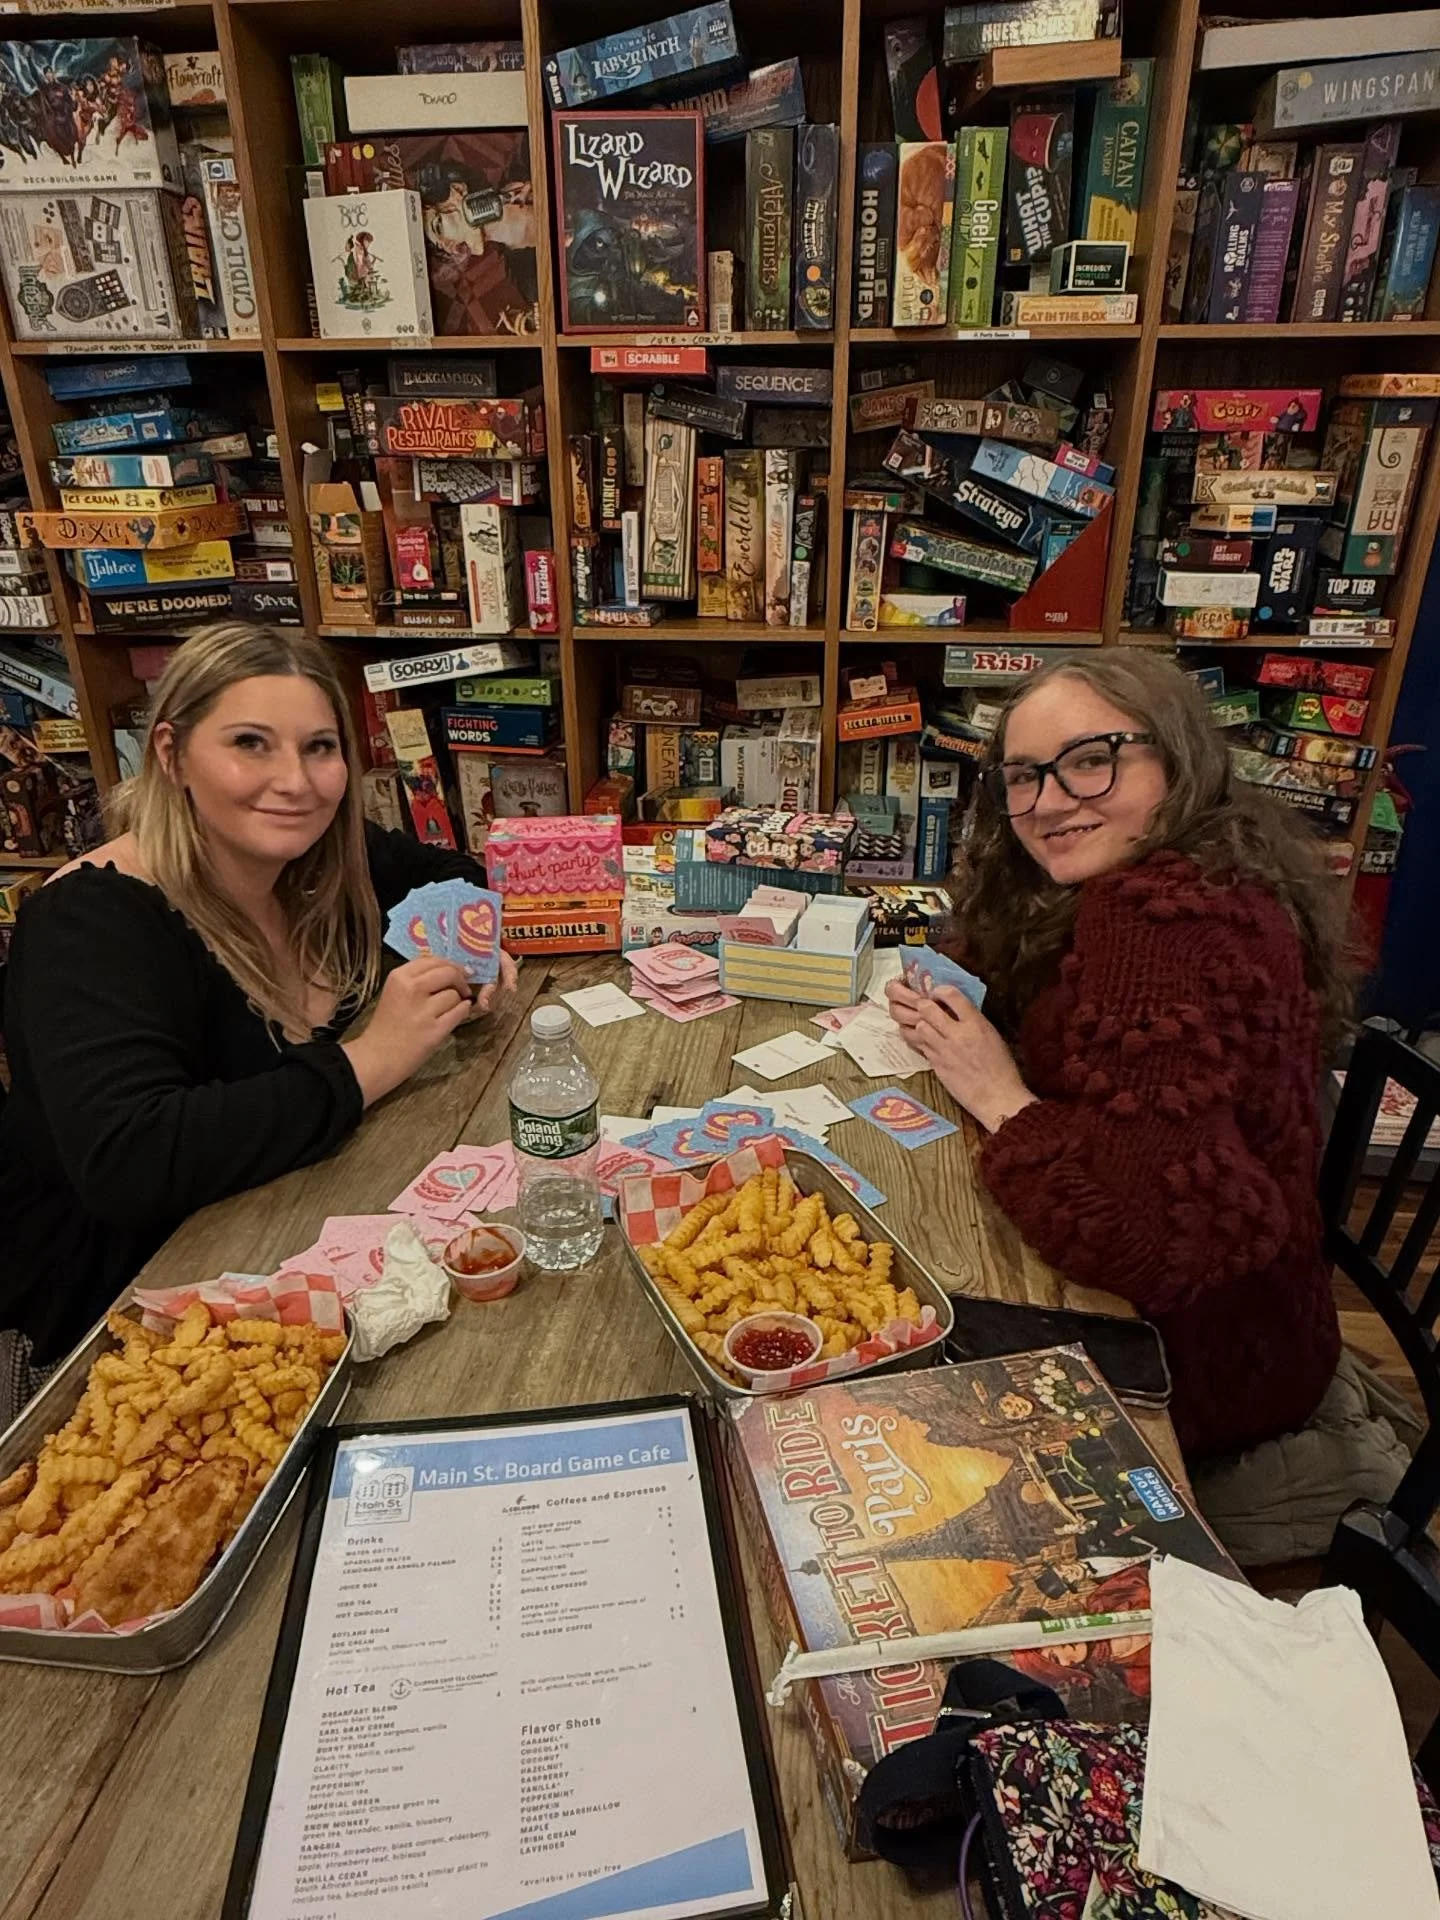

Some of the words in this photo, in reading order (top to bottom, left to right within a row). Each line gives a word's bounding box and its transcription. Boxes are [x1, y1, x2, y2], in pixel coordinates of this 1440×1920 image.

[435, 54, 464, 73] Moon
[591, 35, 682, 80] LABYRINTH
[1324, 71, 1435, 105] WINGSPAN
[1101, 136, 1113, 176] JUNIOR
[1117, 121, 1139, 189] CATAN
[93, 174, 118, 183] GAME
[758, 160, 784, 286] Alchemists
[969, 199, 998, 248] Geek
[1016, 192, 1042, 254] WHAT
[1320, 199, 1344, 230] My
[1041, 225, 1053, 248] THE
[182, 196, 217, 305] TRAINS
[858, 188, 879, 322] HORRIFIED
[1223, 224, 1240, 273] ROLLING
[1235, 229, 1249, 267] REALMS
[1020, 311, 1047, 323] CAT
[1048, 311, 1060, 322] IN
[1060, 311, 1082, 322] THE
[1083, 310, 1108, 322] BOX
[692, 335, 720, 345] COZY
[624, 351, 680, 366] SCRABBLE
[403, 371, 484, 387] BACKGAMMON
[735, 374, 814, 393] SEQUENCE
[399, 401, 460, 431] RIVAL
[667, 400, 724, 419] MASTERMIND
[386, 426, 477, 452] RESTAURANTS
[64, 495, 83, 504] ICE
[85, 494, 121, 505] CREAM
[602, 477, 616, 518] DISTRICT
[953, 479, 1024, 530] Stratego
[727, 494, 758, 580] Everdell
[1213, 545, 1228, 553] ART
[89, 556, 137, 582] Yahtzee
[1269, 549, 1284, 589] STAR
[1274, 548, 1296, 593] WARS
[414, 592, 429, 600] Mind
[1327, 578, 1349, 595] TOP
[1350, 579, 1376, 595] TIER
[106, 598, 160, 616] WE'RE
[161, 593, 233, 611] DOOMED!
[1193, 608, 1231, 624] VEGAS
[393, 657, 450, 680] SORRY!
[973, 653, 1042, 673] Risk
[447, 717, 499, 732] FIGHTING
[447, 729, 491, 743] WORDS
[661, 726, 677, 788] UNEART
[866, 743, 879, 796] VITICU
[780, 776, 800, 813] RIDE
[548, 855, 600, 878] party
[551, 922, 600, 938] HITLER
[874, 926, 899, 936] STEAL
[517, 1117, 561, 1136] Poland
[519, 1131, 563, 1149] Spring
[763, 1398, 853, 1505] RIDE
[418, 1469, 468, 1486] Main
[472, 1464, 500, 1482] St.
[505, 1457, 563, 1480] Board
[567, 1452, 624, 1473] Game
[628, 1444, 671, 1465] Cafe
[840, 1413, 932, 1538] Paris
[546, 1495, 587, 1508] Coffees
[591, 1492, 610, 1502] and
[613, 1484, 667, 1499] Espressos
[1143, 1471, 1179, 1514] WONDER
[355, 1500, 385, 1511] Main
[1144, 1490, 1166, 1515] DAYS
[810, 1503, 867, 1548] TO
[565, 1623, 593, 1633] COFFEE
[326, 1685, 349, 1697] Hot
[353, 1683, 376, 1694] Tea
[321, 1707, 369, 1718] BREAKFAST
[371, 1705, 399, 1713] BLEND
[319, 1728, 340, 1737] EARL
[521, 1722, 562, 1736] Flavor
[565, 1716, 601, 1730] Shots
[520, 1743, 570, 1755] CHOCOLATE
[313, 1763, 350, 1773] CLARITY
[520, 1754, 560, 1765] COCONUT
[520, 1762, 564, 1775] HAZELNUT
[310, 1780, 366, 1792] PEPPERMINT
[520, 1771, 570, 1784] RASPBERRY
[307, 1801, 349, 1812] IMPERIAL
[351, 1797, 380, 1807] GREEN
[520, 1789, 575, 1804] PEPPERMINT
[520, 1802, 560, 1814] PUMPKIN
[520, 1811, 560, 1823] TOASTED
[304, 1823, 330, 1832] SNOW
[333, 1818, 369, 1829] MONKEY
[520, 1823, 550, 1834] MAPLE
[520, 1835, 544, 1845] IRISH
[547, 1829, 577, 1841] CREAM
[301, 1842, 341, 1852] SANGRIA
[520, 1841, 566, 1855] LAVENDER
[296, 1874, 335, 1885] VANILLA
[338, 1870, 369, 1880] CEDAR
